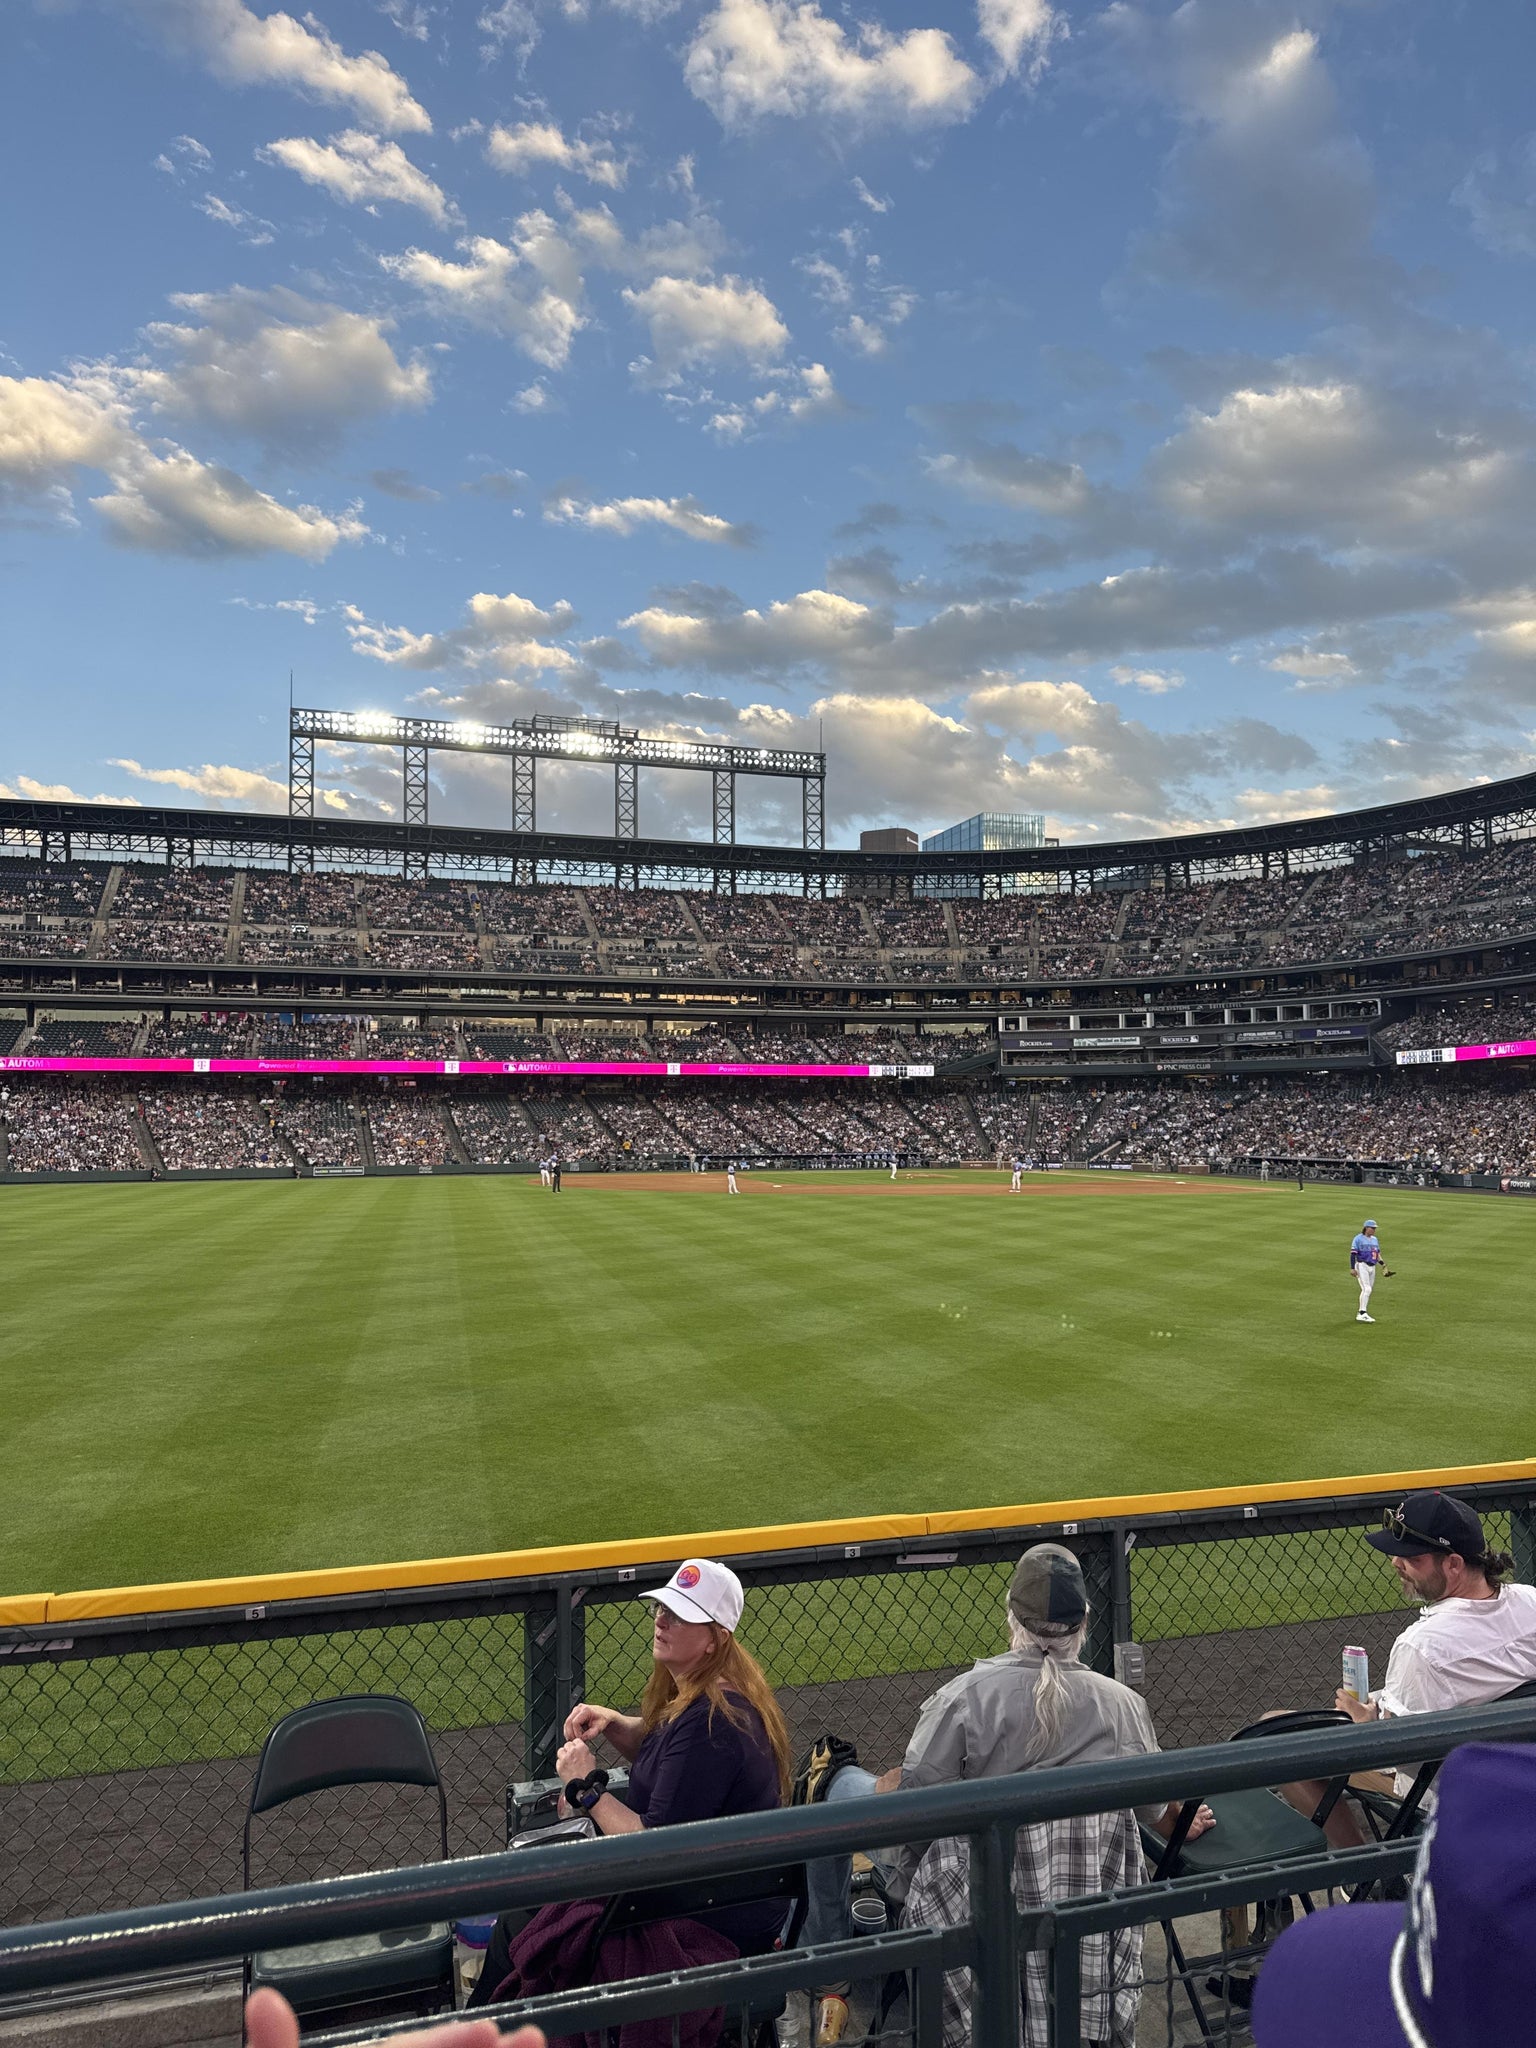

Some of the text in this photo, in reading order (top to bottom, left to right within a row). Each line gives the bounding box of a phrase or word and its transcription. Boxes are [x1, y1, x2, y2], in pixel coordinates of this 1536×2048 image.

[1510, 1180, 1531, 1188] TOYOTA
[1067, 1525, 1073, 1534] 2
[849, 1548, 856, 1557] 3
[623, 1571, 631, 1580] 4
[252, 1609, 260, 1619] 5
